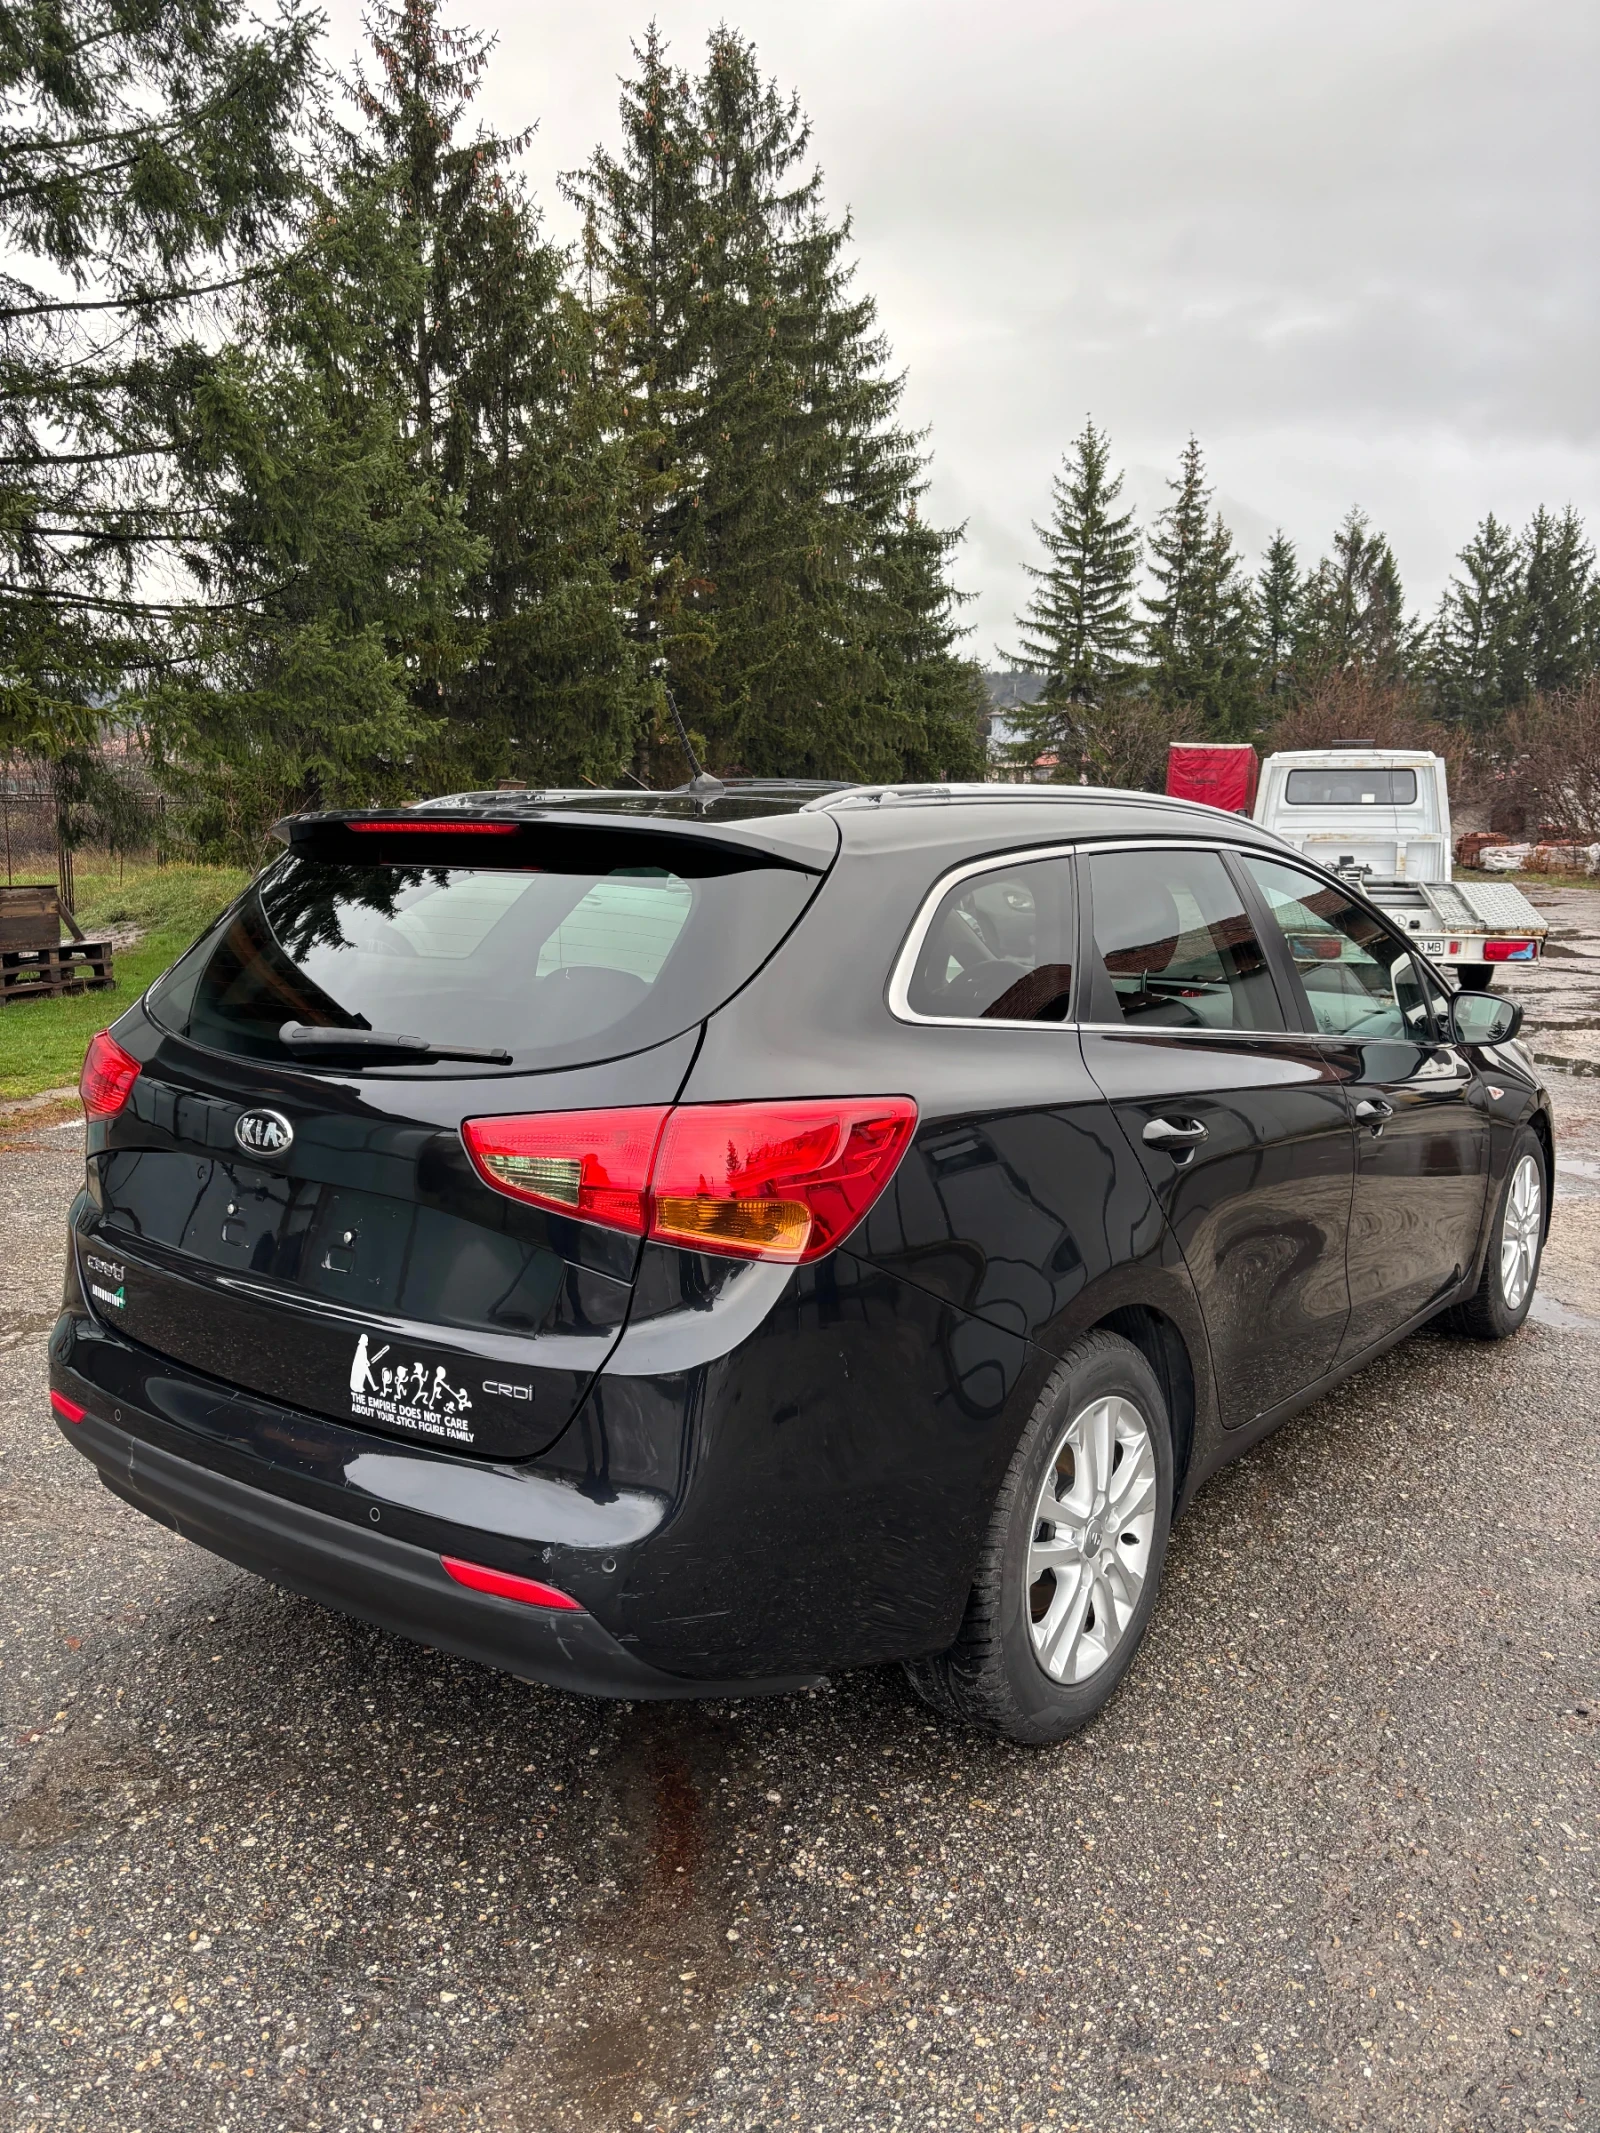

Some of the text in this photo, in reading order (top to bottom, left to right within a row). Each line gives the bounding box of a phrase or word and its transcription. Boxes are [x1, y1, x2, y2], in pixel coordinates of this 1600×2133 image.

[1427, 942, 1441, 952] MB
[241, 1117, 280, 1148] KIA
[350, 1392, 469, 1431] THE EMPIRE DOES NOT CARE
[351, 1402, 475, 1443] ABOUT YOUR STICK FIGURE FAMILY
